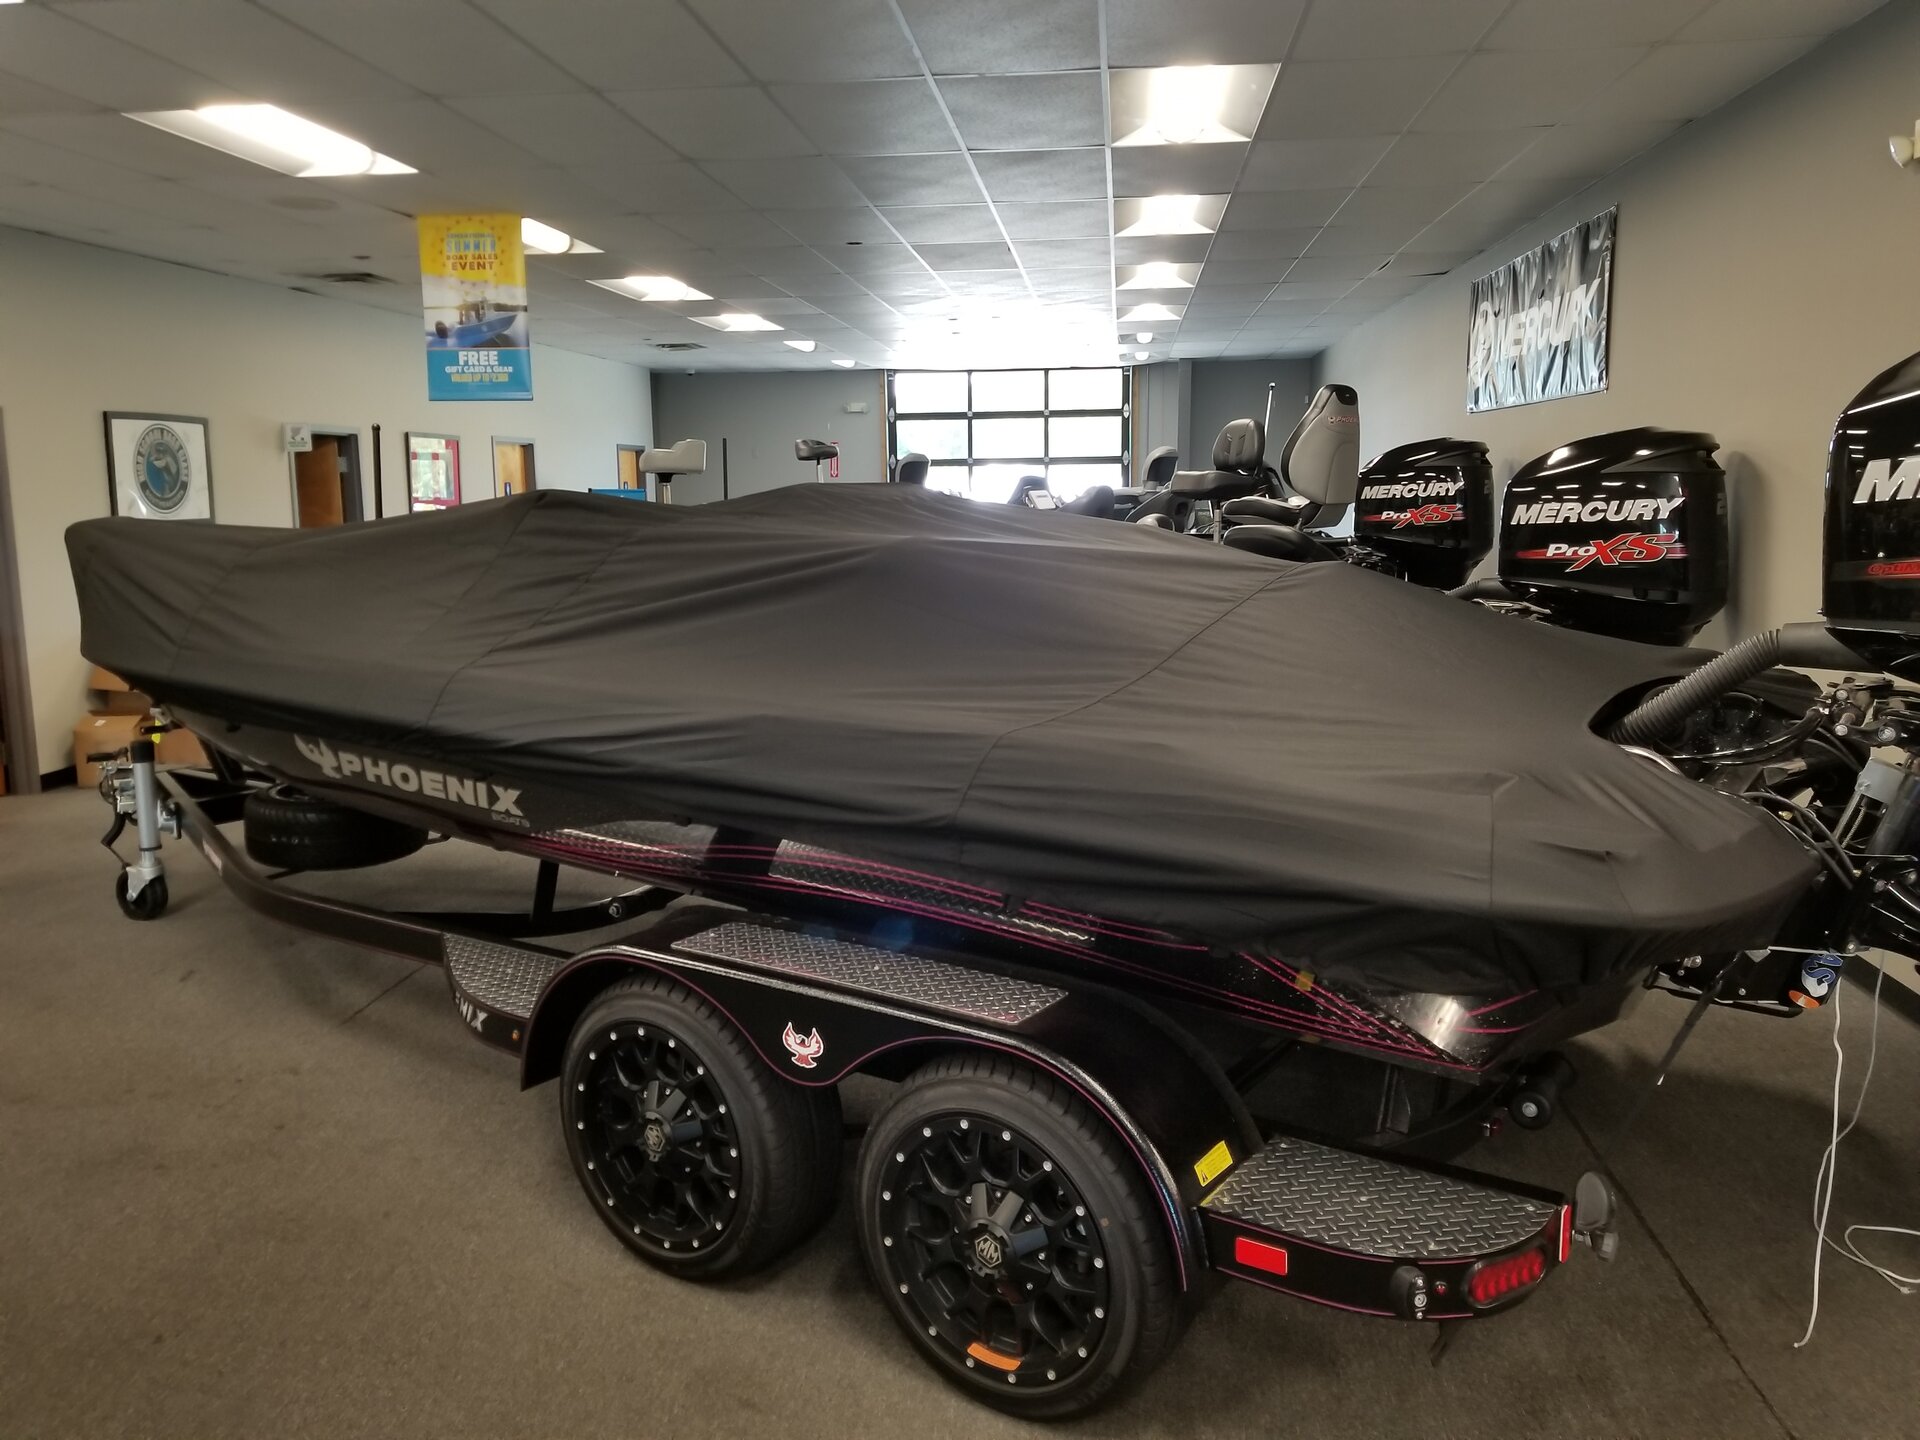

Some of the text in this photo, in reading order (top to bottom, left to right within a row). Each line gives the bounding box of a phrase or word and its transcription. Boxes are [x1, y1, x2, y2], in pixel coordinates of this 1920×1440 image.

[451, 261, 495, 270] EVENT
[458, 350, 498, 365] FREE
[445, 365, 462, 373] GIFT
[1361, 482, 1465, 499] MERCURY
[1510, 497, 1686, 526] MERCURY
[338, 751, 524, 817] PHOENIX
